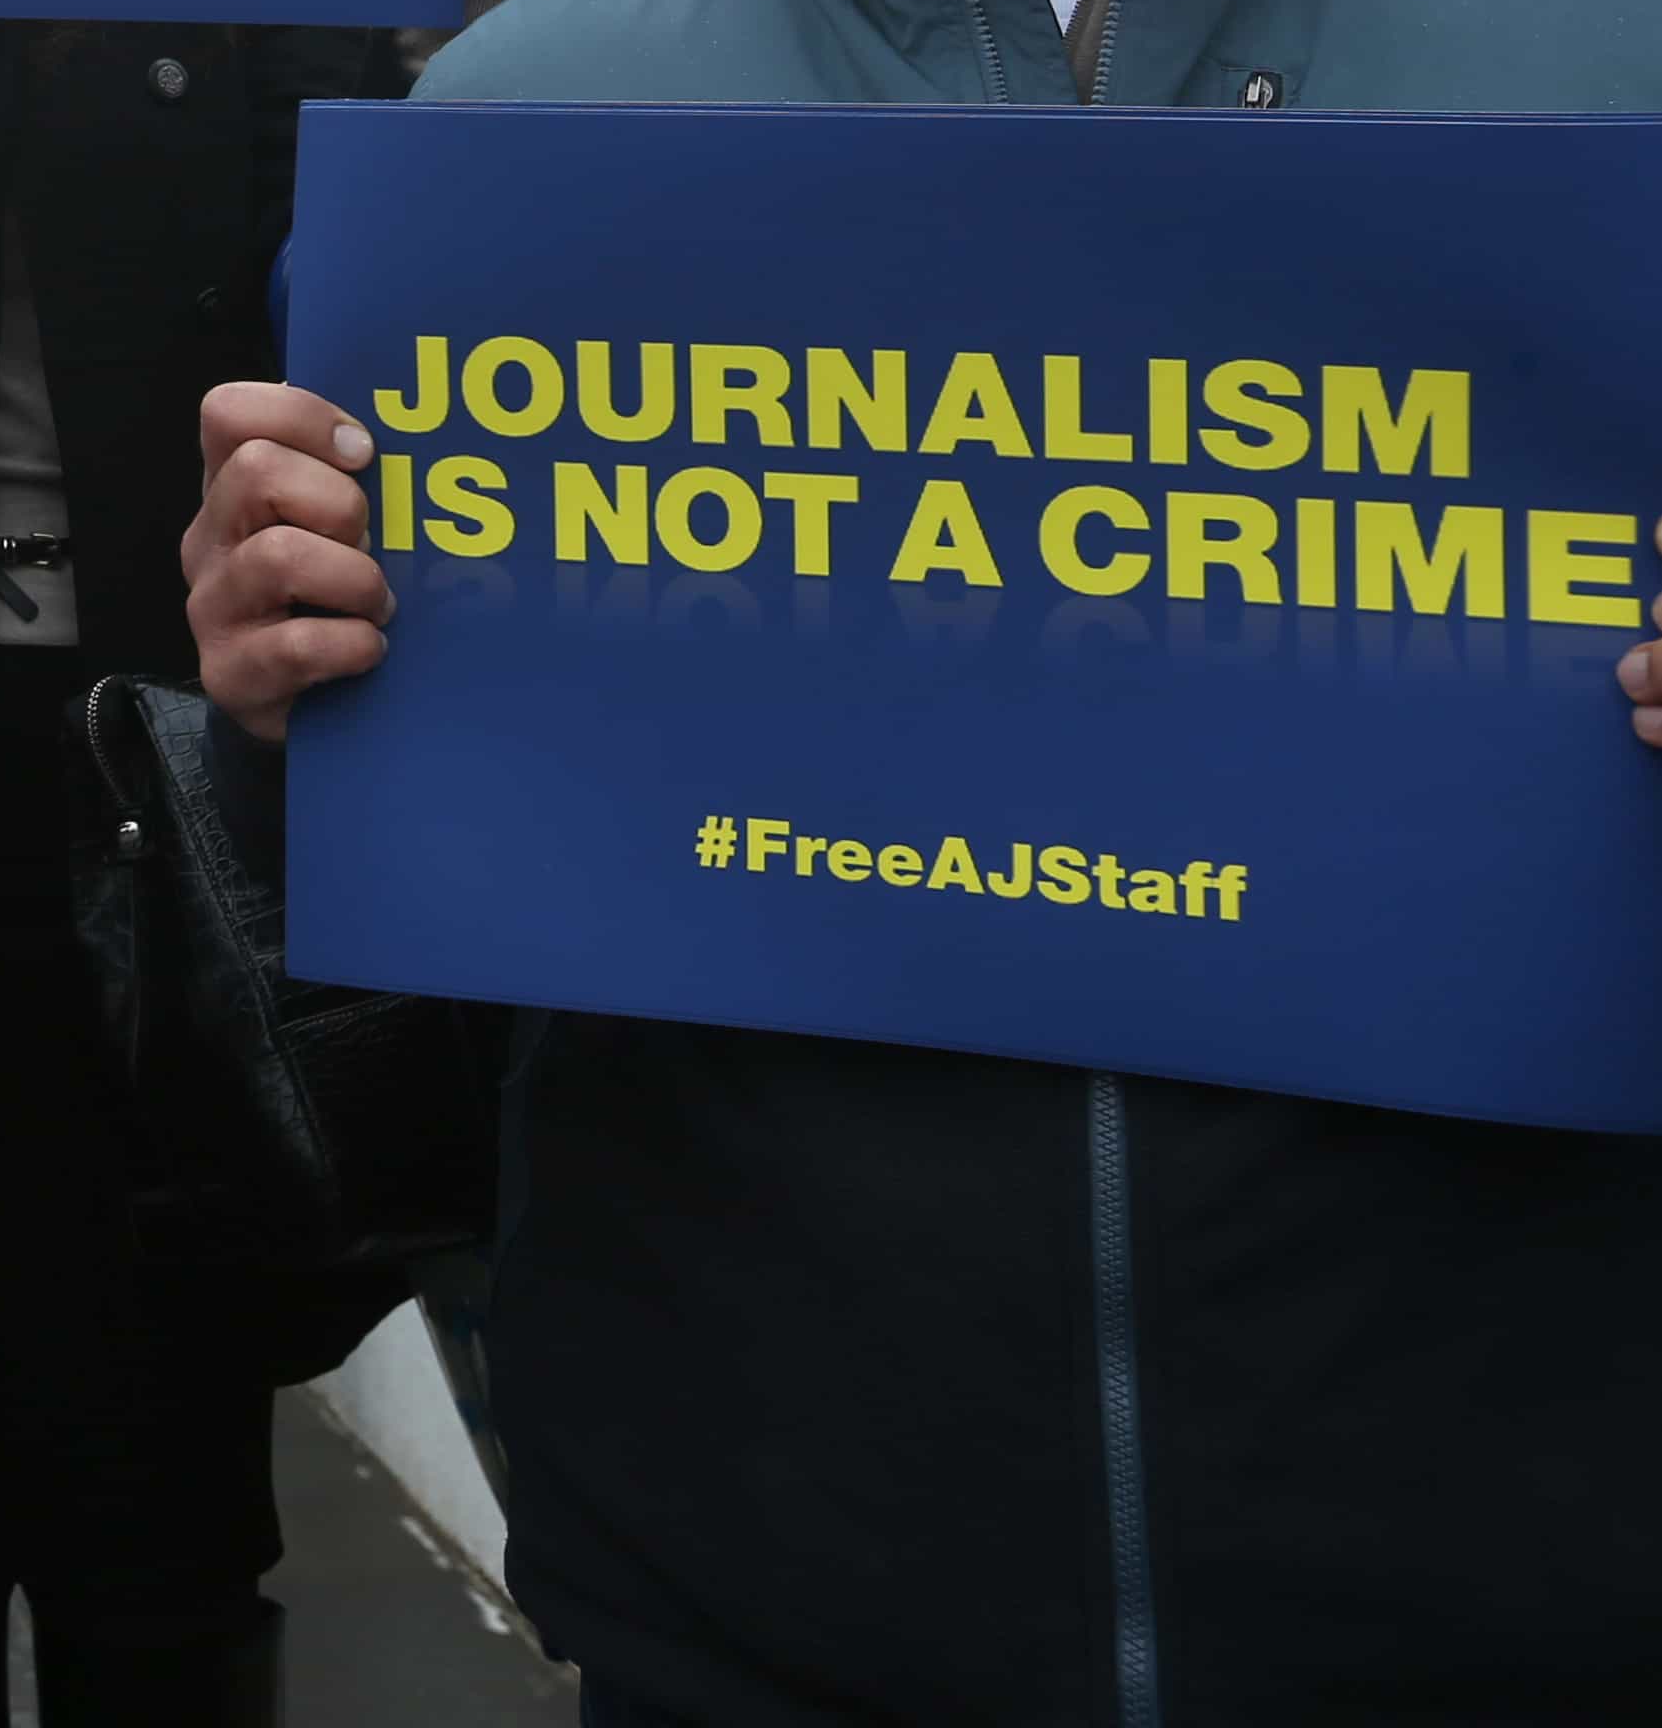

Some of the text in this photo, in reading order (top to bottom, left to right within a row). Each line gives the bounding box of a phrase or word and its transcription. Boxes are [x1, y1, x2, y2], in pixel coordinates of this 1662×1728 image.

[374, 336, 1471, 477] JOURNALISM
[380, 454, 1642, 627] IS NOT A CRIME
[697, 816, 1247, 920] #FreeAJStaff
